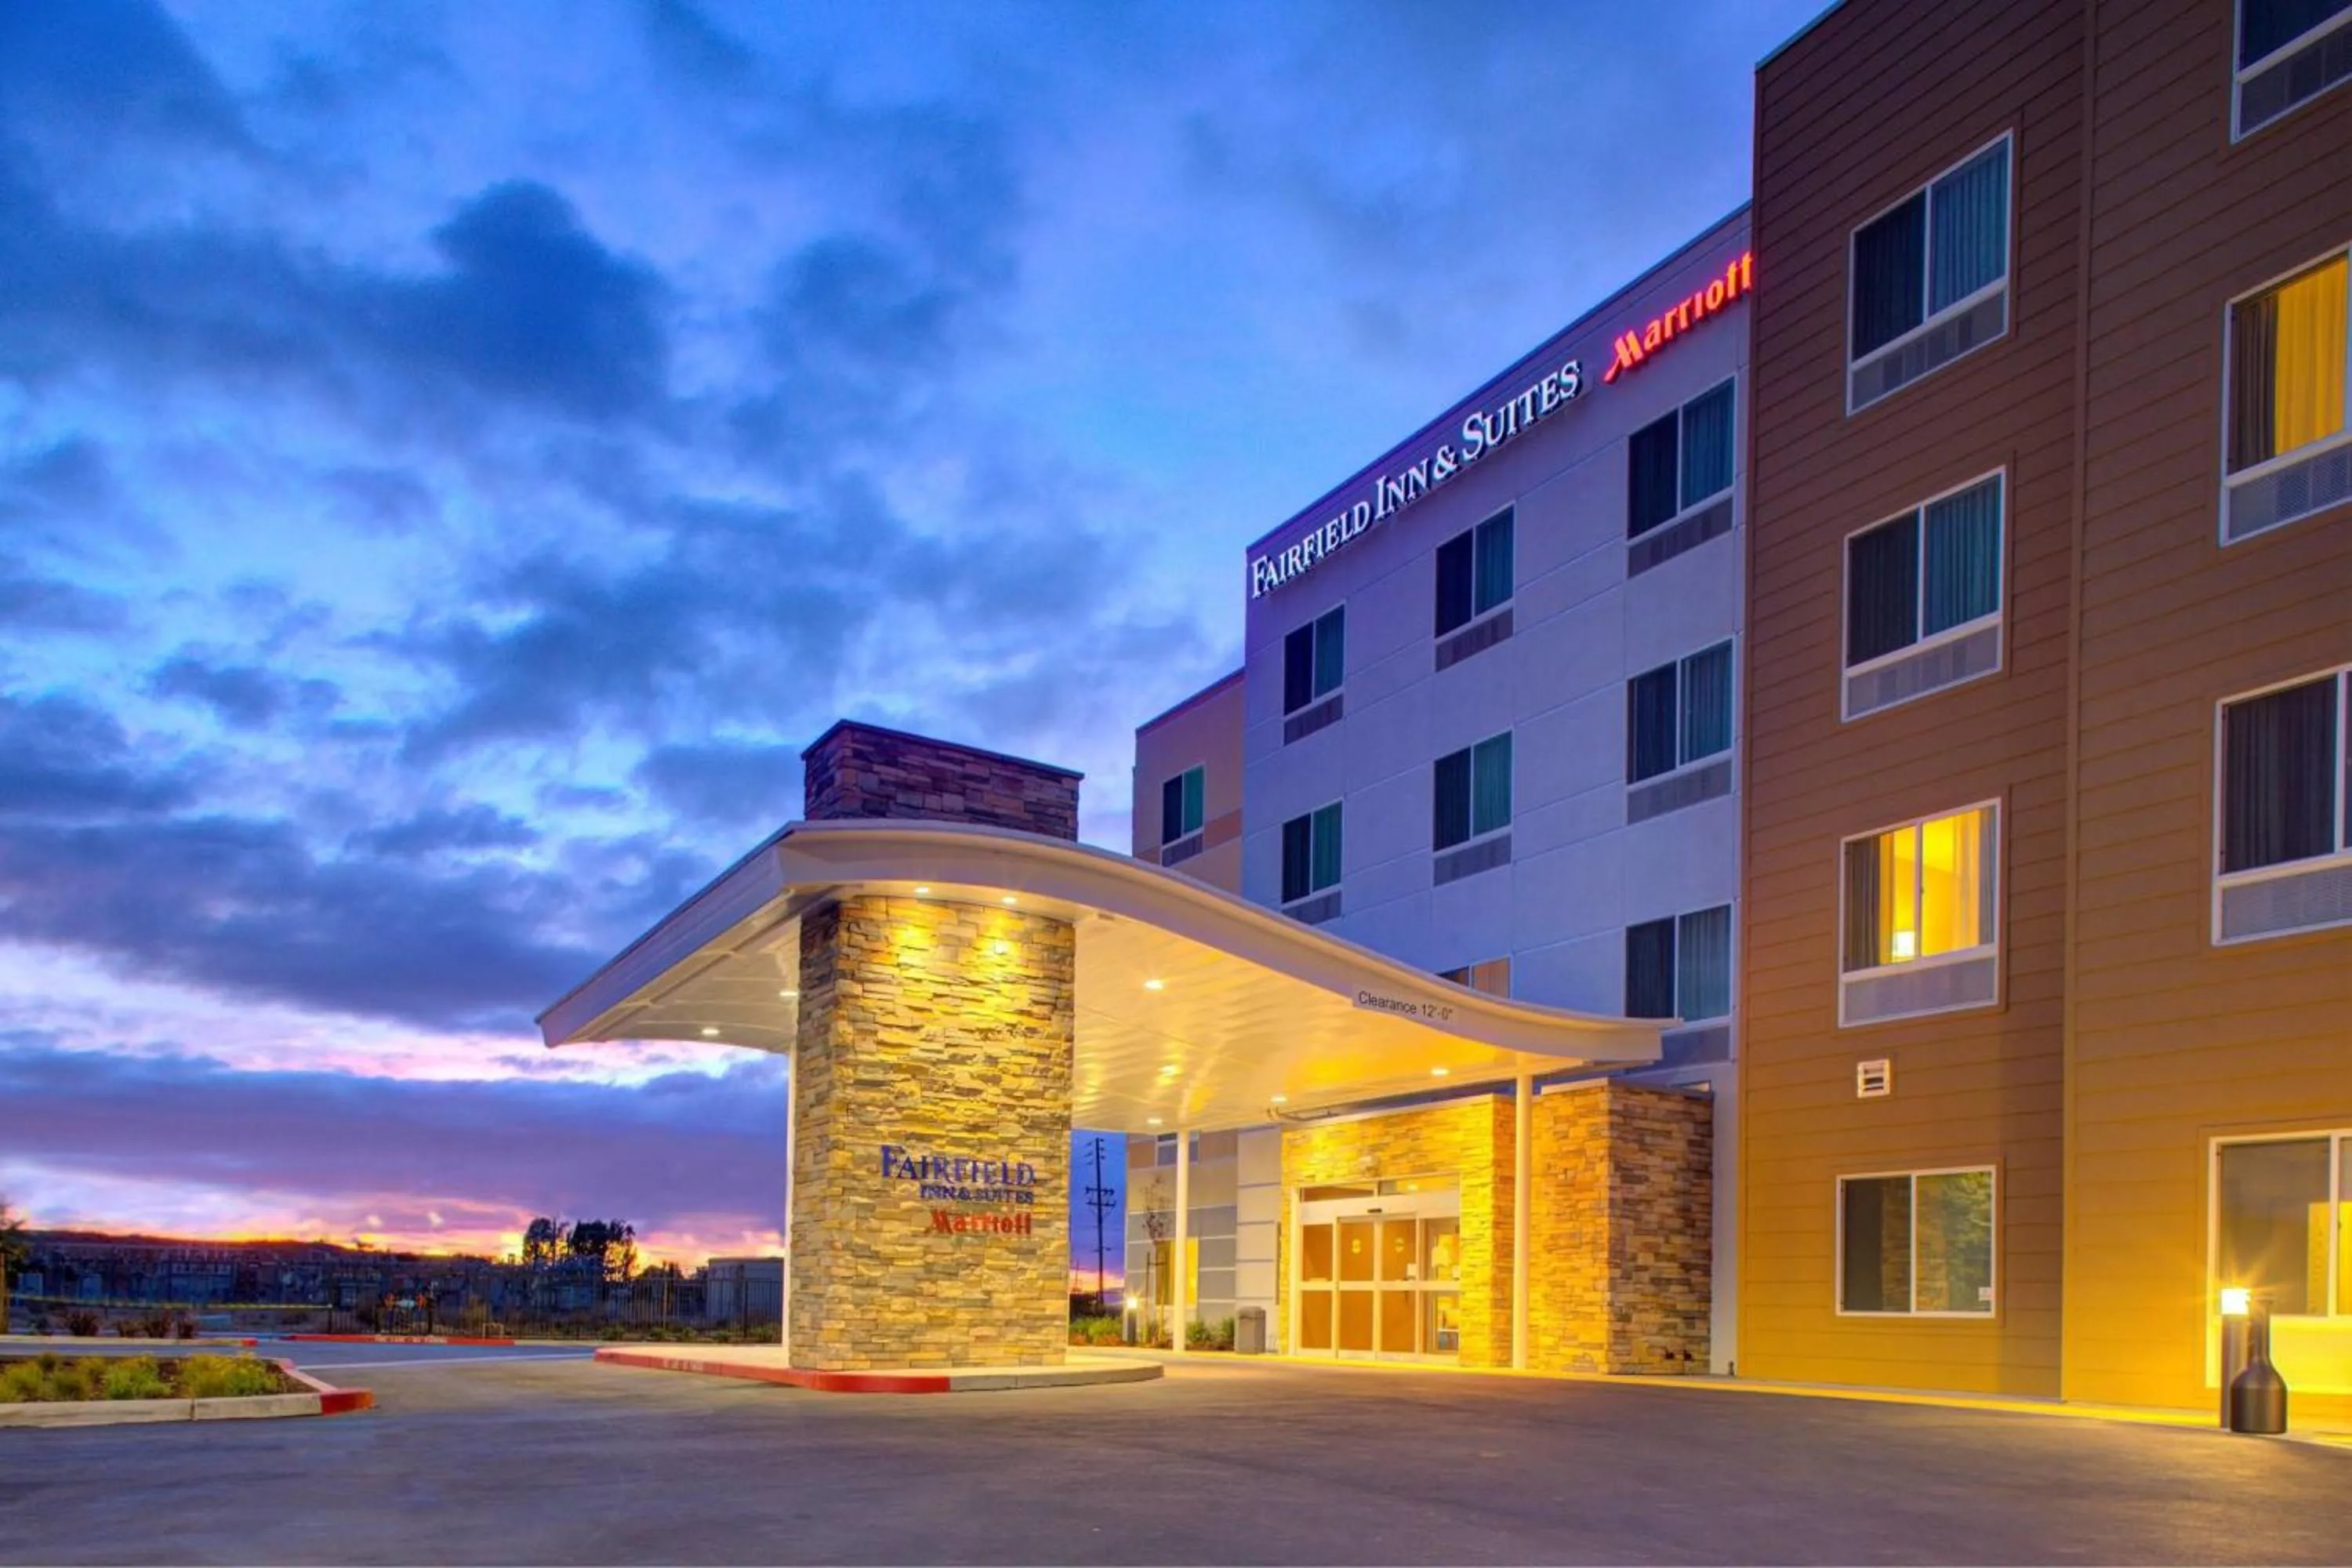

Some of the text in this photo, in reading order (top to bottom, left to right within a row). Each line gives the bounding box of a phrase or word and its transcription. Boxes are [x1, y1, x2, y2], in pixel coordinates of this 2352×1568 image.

[1603, 249, 1752, 383] Marriott
[1251, 359, 1581, 599] FAIRFIELD INN & SUITES
[1358, 990, 1417, 1014] Clearance
[880, 1144, 1036, 1186] FAIRFIELD
[920, 1184, 956, 1200] INN
[976, 1187, 1035, 1205] SUITES
[925, 1208, 1033, 1235] Marriott
